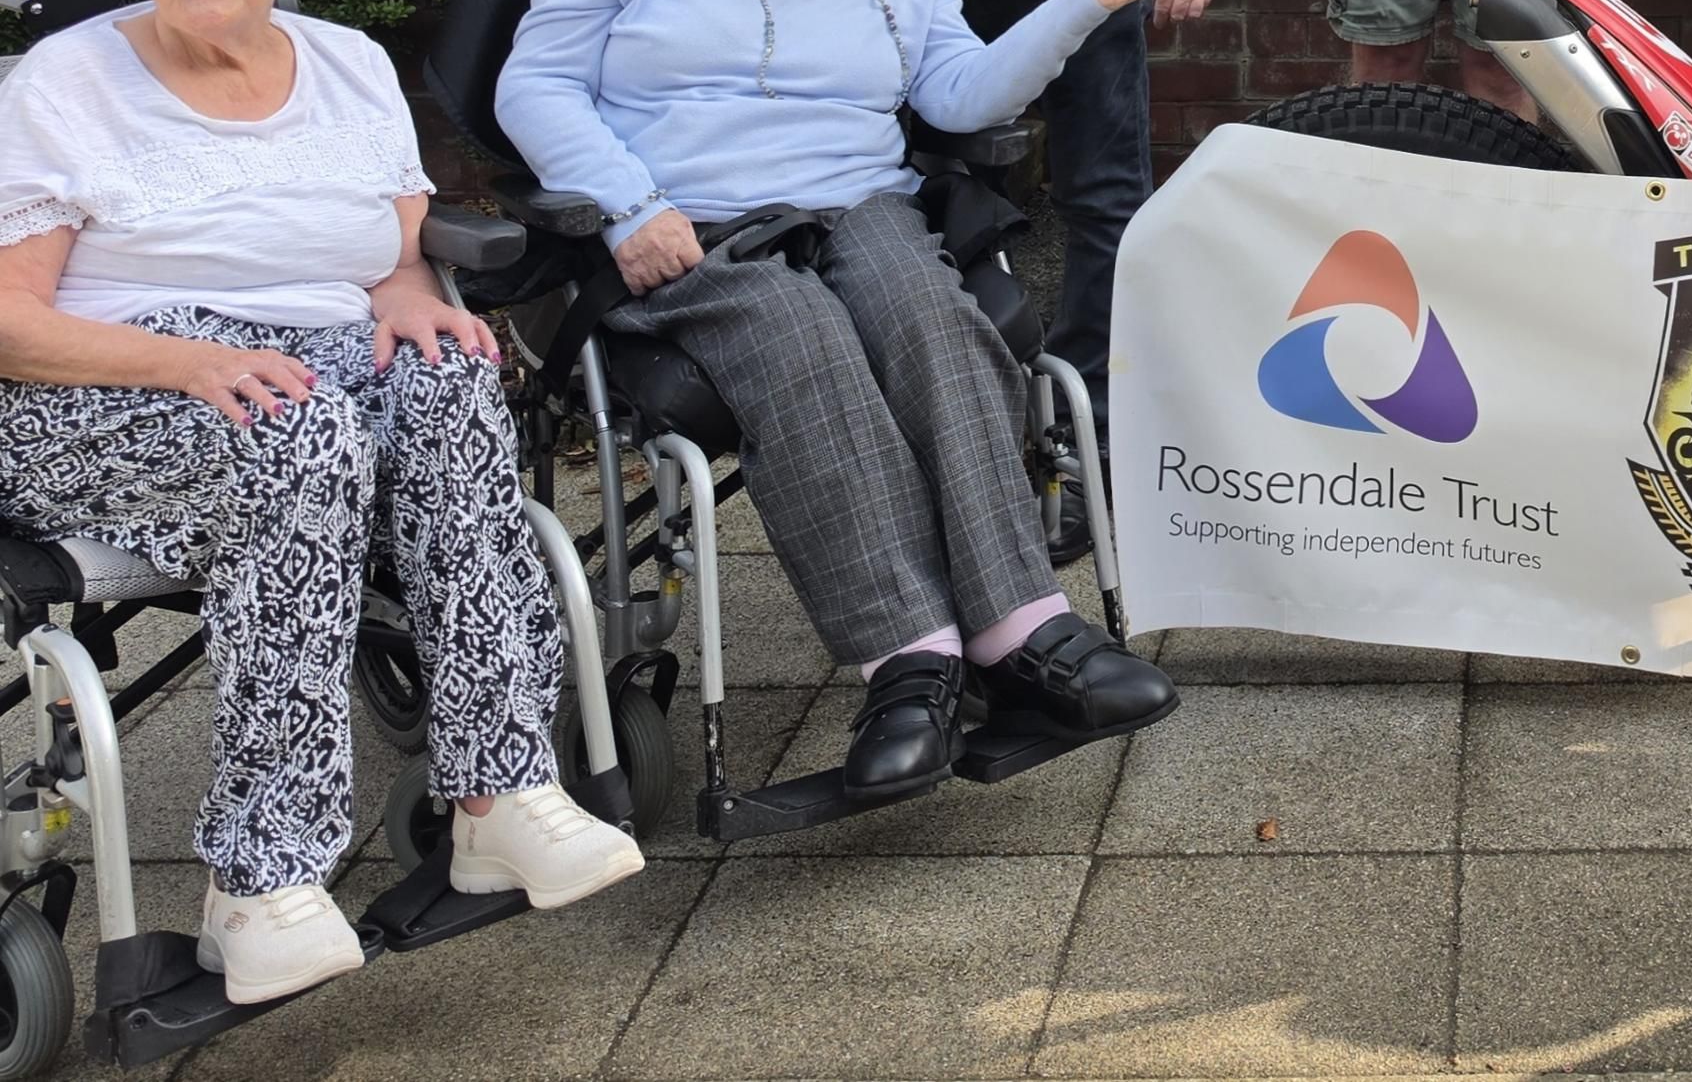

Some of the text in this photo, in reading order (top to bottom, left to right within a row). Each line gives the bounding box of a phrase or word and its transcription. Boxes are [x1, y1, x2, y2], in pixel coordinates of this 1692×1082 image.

[1157, 445, 1560, 537] Rossendale Trust
[1169, 513, 1542, 571] Supporting independent futures
